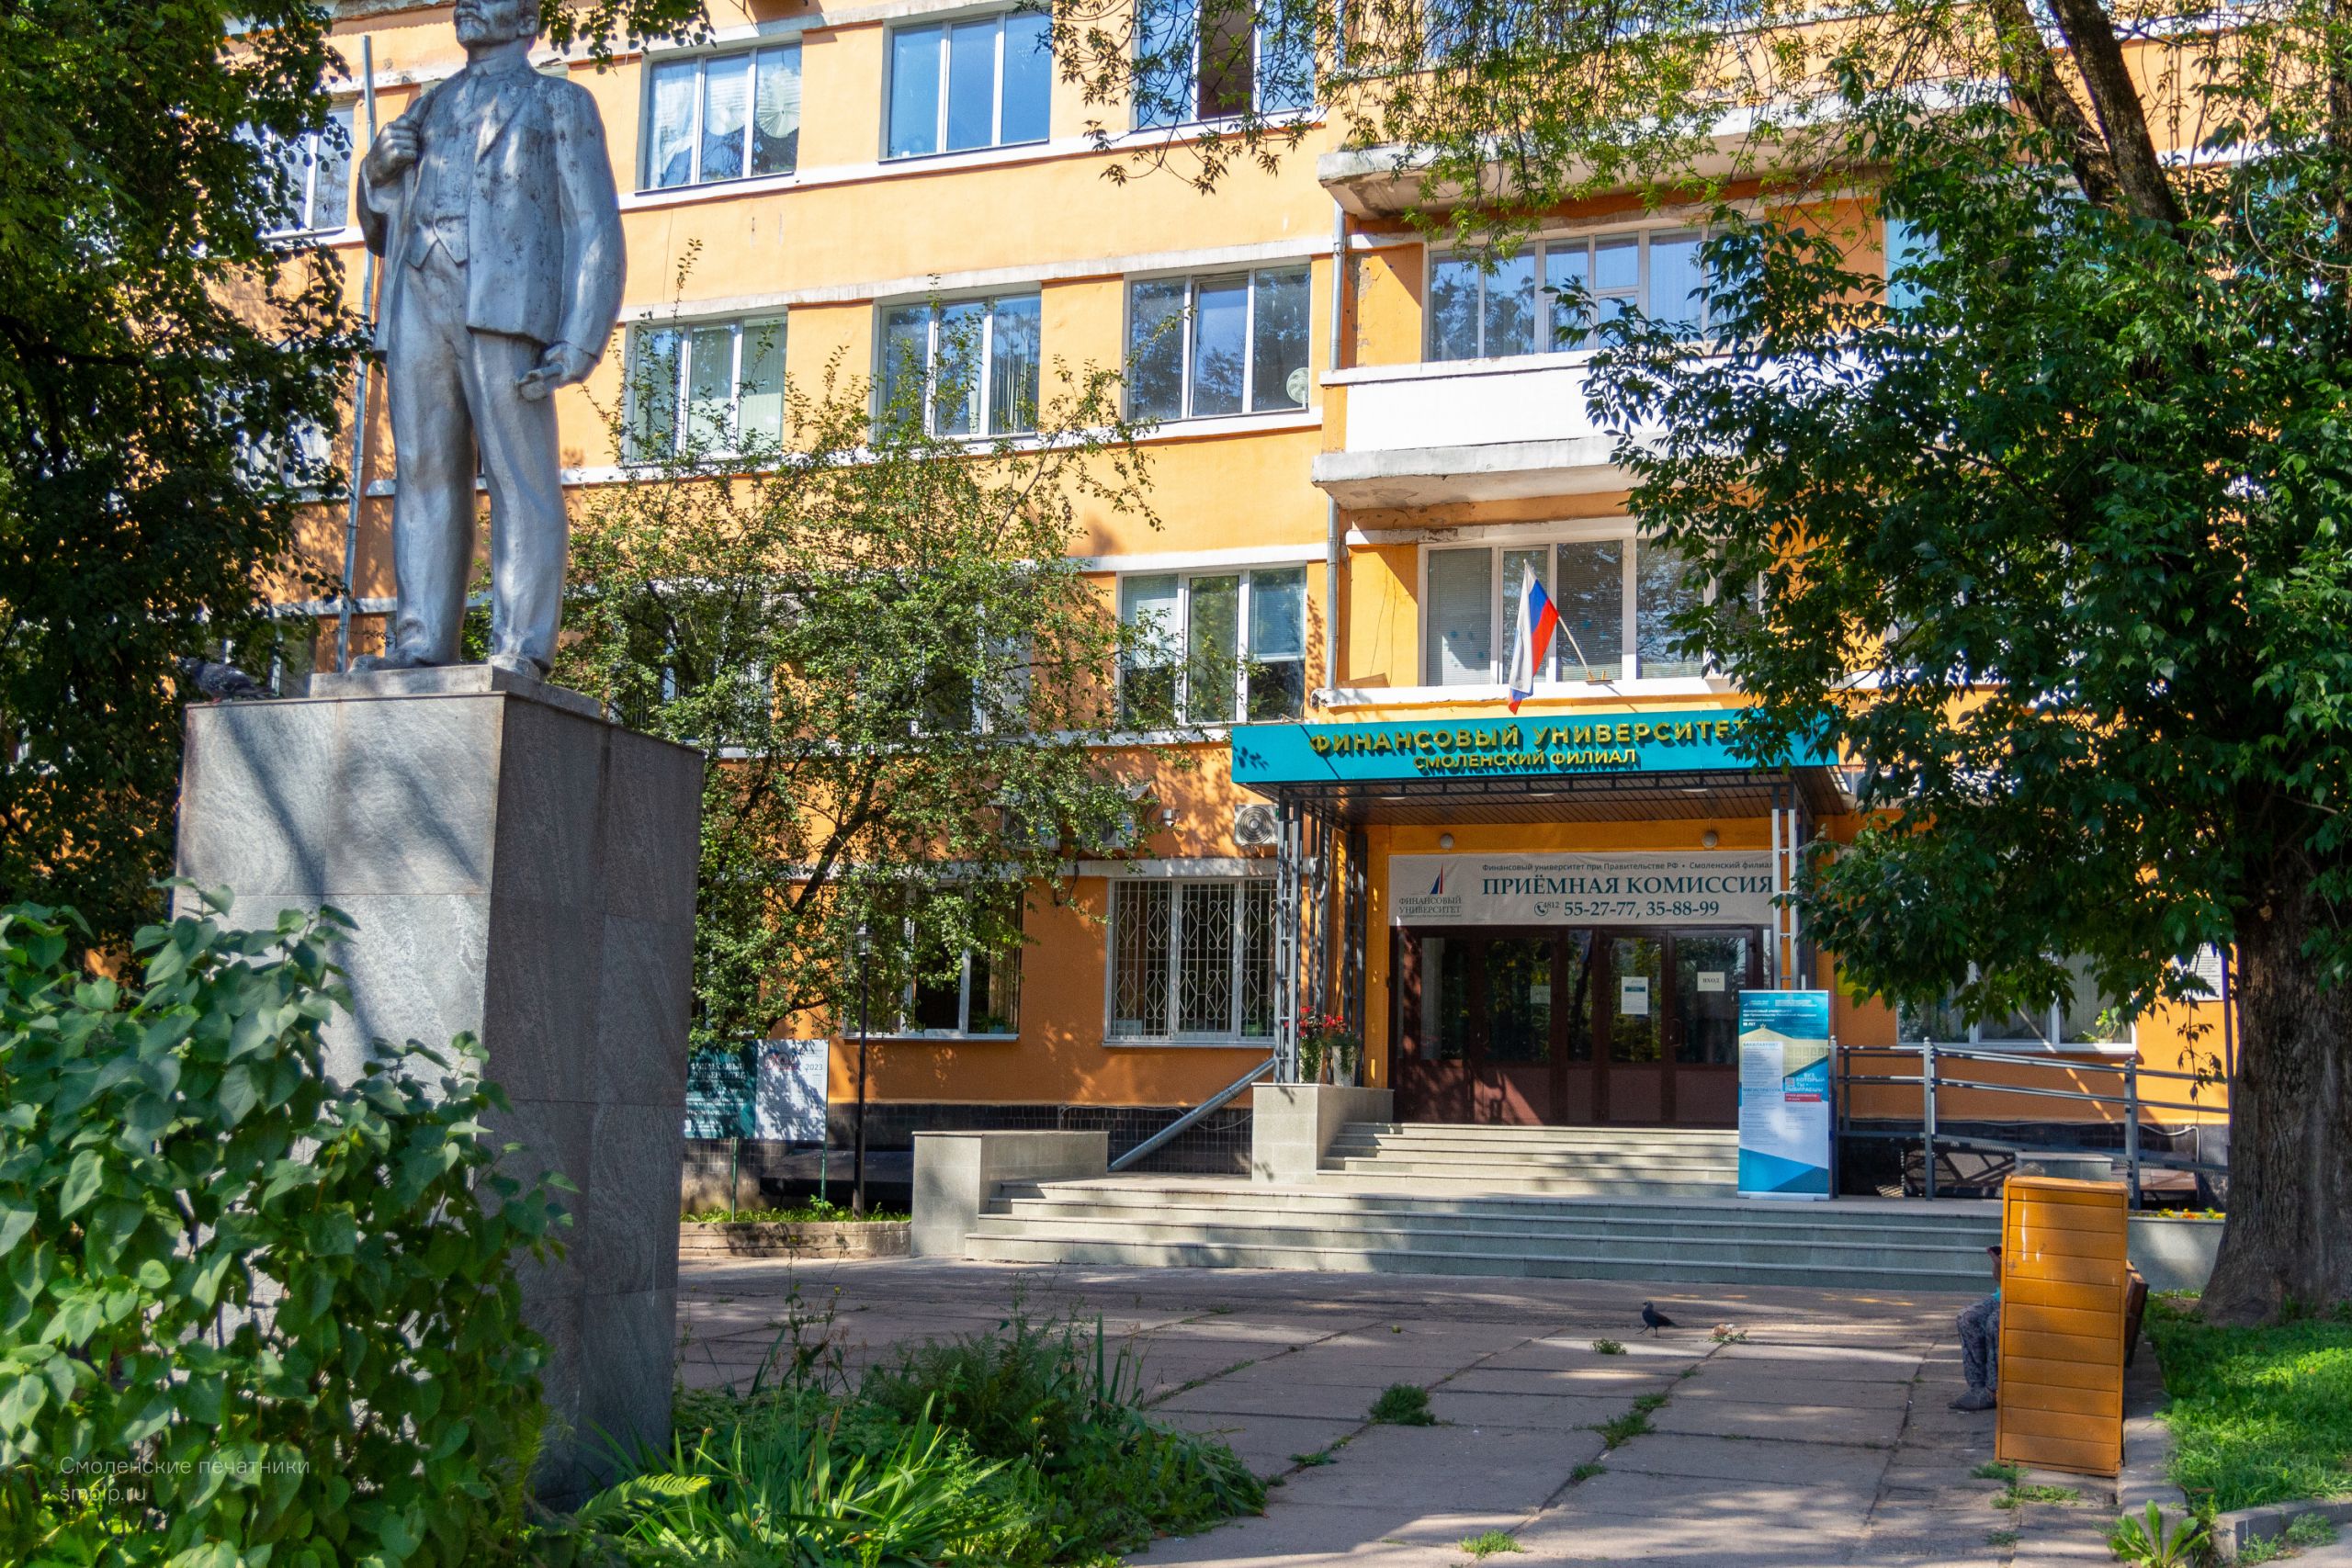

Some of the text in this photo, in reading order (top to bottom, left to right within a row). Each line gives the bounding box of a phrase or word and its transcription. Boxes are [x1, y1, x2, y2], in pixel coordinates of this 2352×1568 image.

[1309, 720, 1749, 752] ФИНАНСОВЫЙ УНИВЕРСИТЕТ
[1413, 749, 1635, 769] СМОЛЕНСКИЙ ФИЛИАЛ
[1482, 863, 1532, 872] Финансовый
[1534, 863, 1585, 873] университет
[1587, 863, 1601, 871] при
[1603, 863, 1665, 872] Правительстве
[1690, 861, 1740, 869] Смоленский
[1482, 874, 1773, 896] ПРИЁМНАЯ КОМИССИЯ
[1398, 896, 1463, 905] ФИНАНСОВЫЙ
[1399, 906, 1462, 914] УНИВЕРСИТЕТ
[1564, 901, 1640, 919] 55-27-77,
[1645, 900, 1720, 917] 35-88-99
